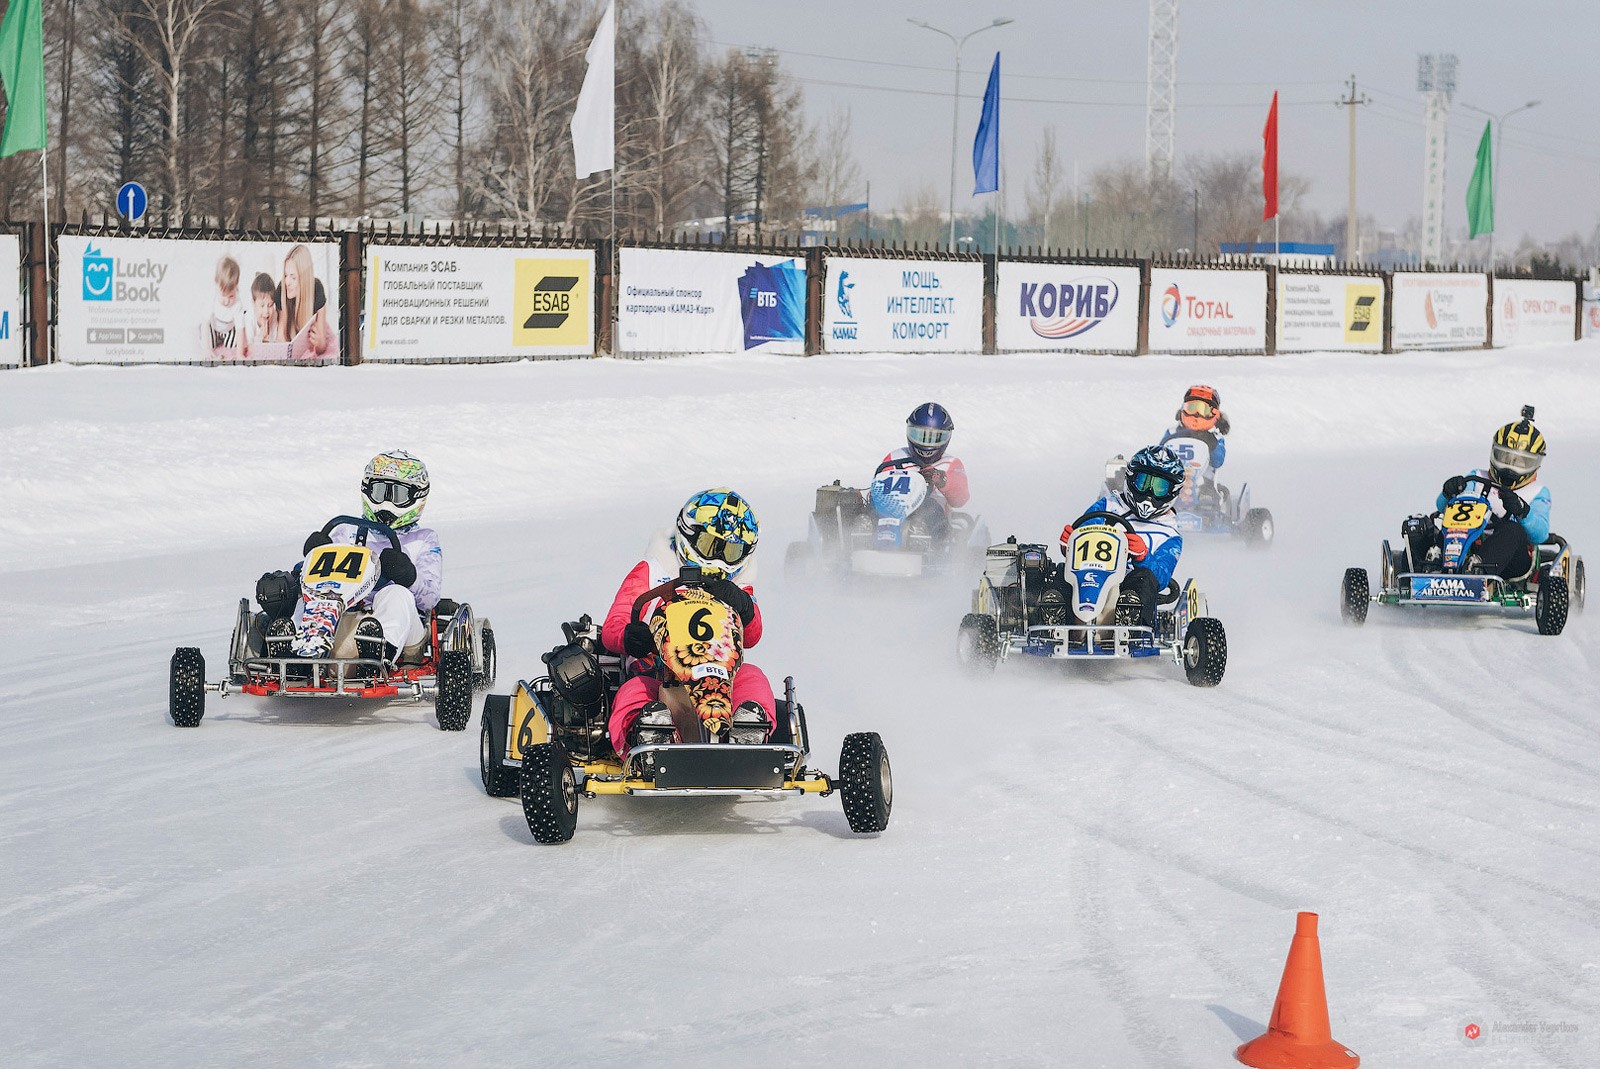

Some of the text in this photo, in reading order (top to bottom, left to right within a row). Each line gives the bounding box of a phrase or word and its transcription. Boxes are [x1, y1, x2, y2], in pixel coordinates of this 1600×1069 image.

[116, 258, 168, 283] Lucky
[901, 270, 943, 292] МОЩЬ.
[116, 282, 160, 302] Book
[626, 285, 703, 301] Официальный спонсор
[757, 291, 777, 307] ВТБ
[1020, 282, 1110, 318] КОРИБ
[533, 292, 570, 312] ESAB
[626, 305, 666, 315] картодрома
[887, 296, 955, 315] ИНТЕЛЛЕКТ.
[381, 316, 398, 327] ДЛЯ
[400, 315, 431, 326] СВАРКИ
[432, 316, 438, 326] И
[440, 315, 464, 326] РЕЗКИ
[892, 321, 950, 340] КОМФОРТ
[832, 327, 858, 340] KAMAZ
[1178, 444, 1195, 461] 5
[882, 476, 911, 495] 14
[1452, 502, 1474, 522] 8
[1077, 540, 1113, 562] 18
[308, 551, 364, 579] 44
[1421, 587, 1475, 598] АВТОДЕТАЛЬ
[1430, 578, 1465, 589] КАМА
[1187, 587, 1198, 619] 18
[688, 607, 714, 641] 6
[706, 666, 725, 676] ВТБ
[517, 707, 535, 754] 6
